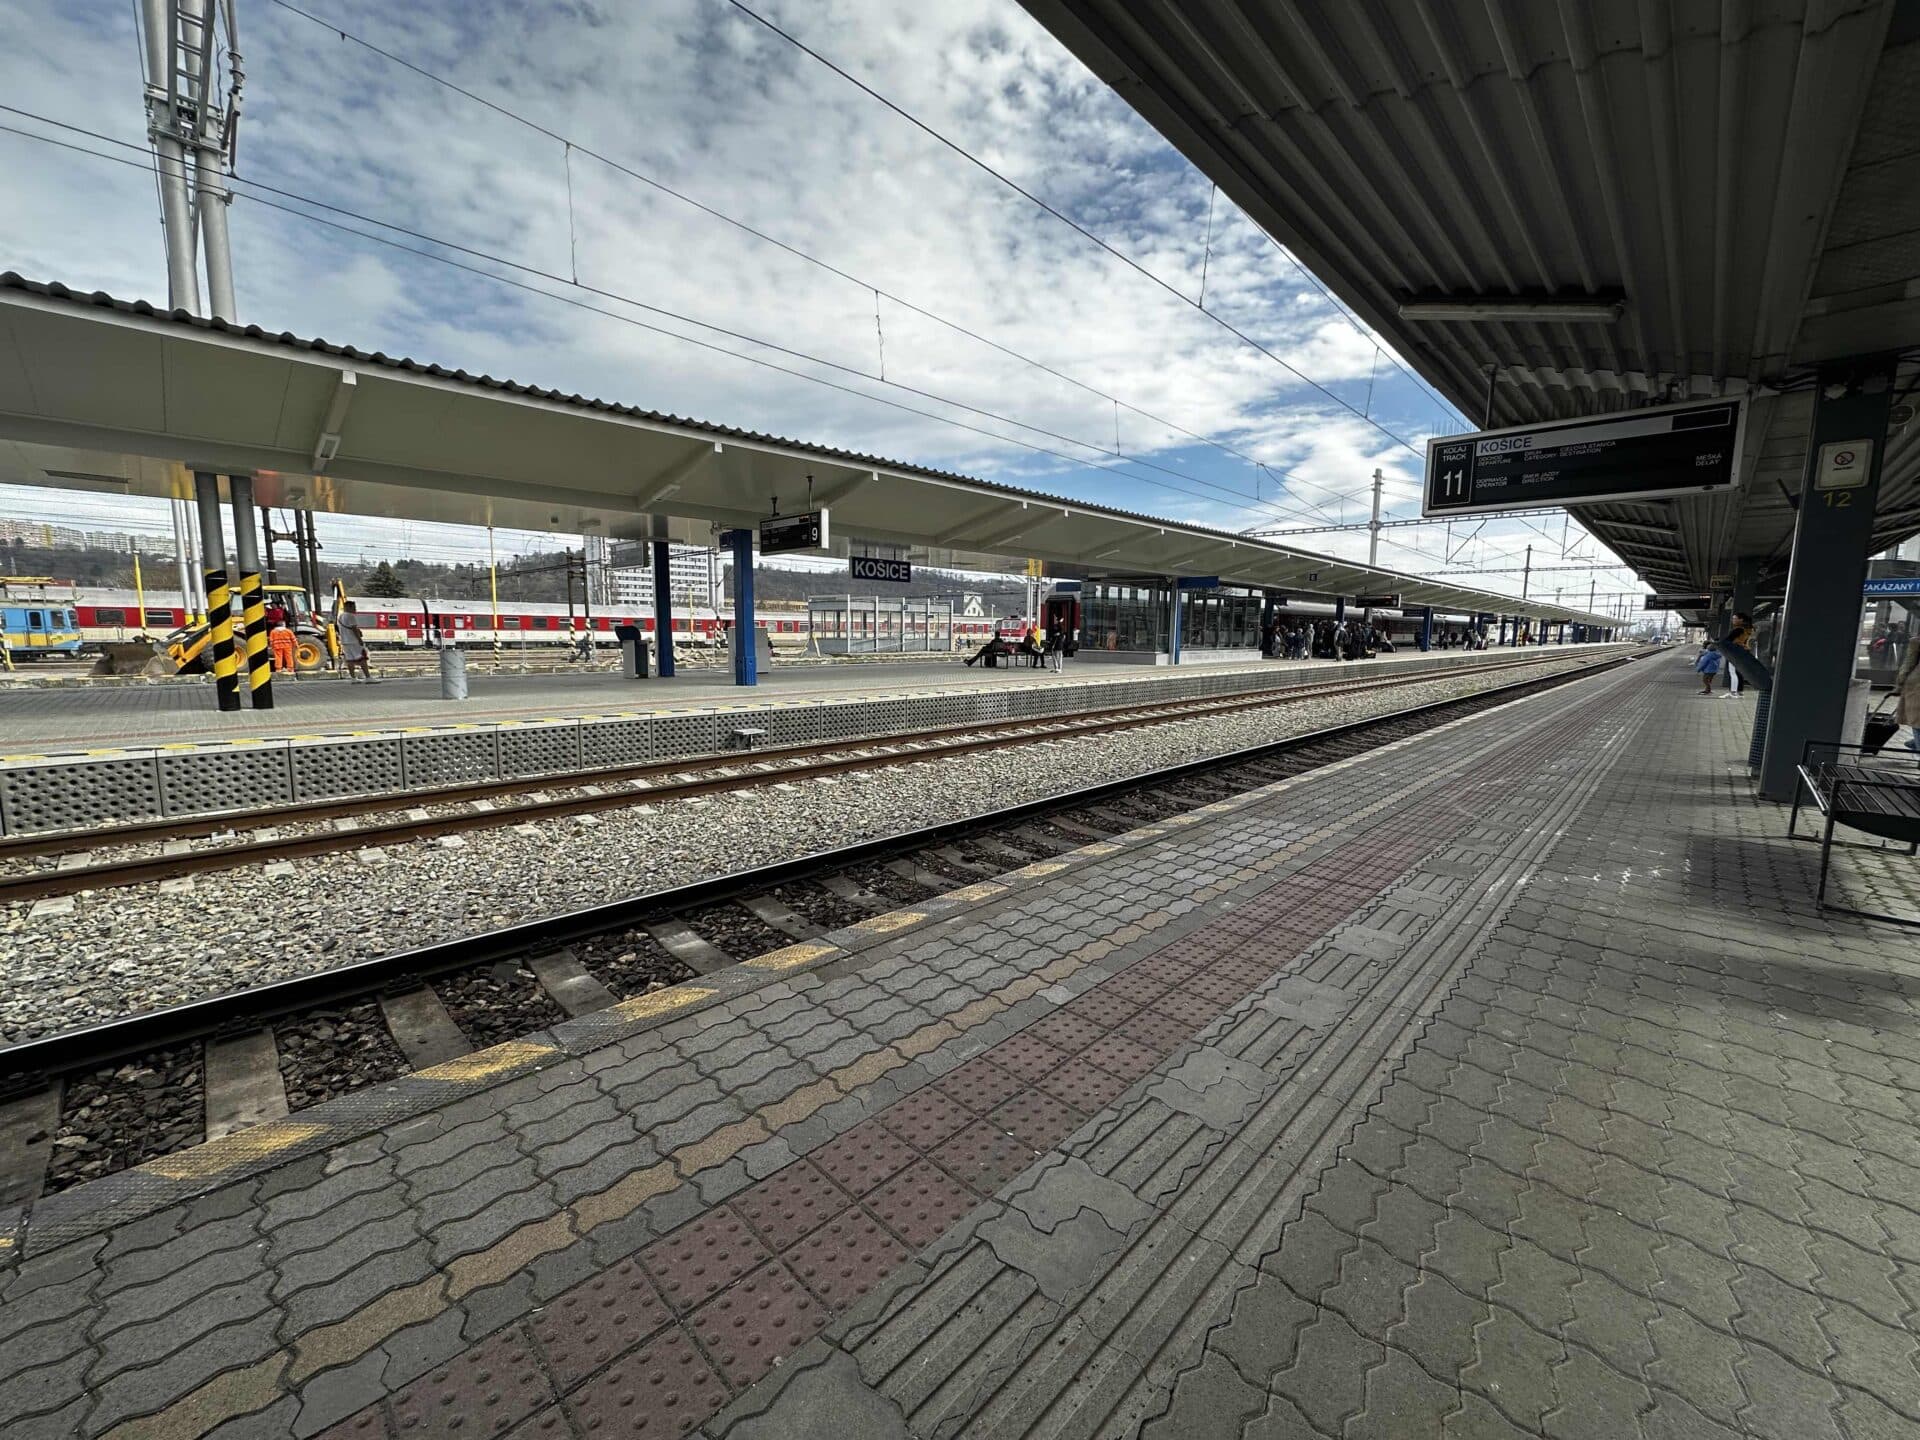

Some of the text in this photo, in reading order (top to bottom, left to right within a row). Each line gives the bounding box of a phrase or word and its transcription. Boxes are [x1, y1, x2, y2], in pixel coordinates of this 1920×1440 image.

[1443, 469, 1463, 496] 11
[1824, 491, 1852, 507] 12
[811, 527, 818, 541] 9
[855, 560, 908, 580] KOŠICE
